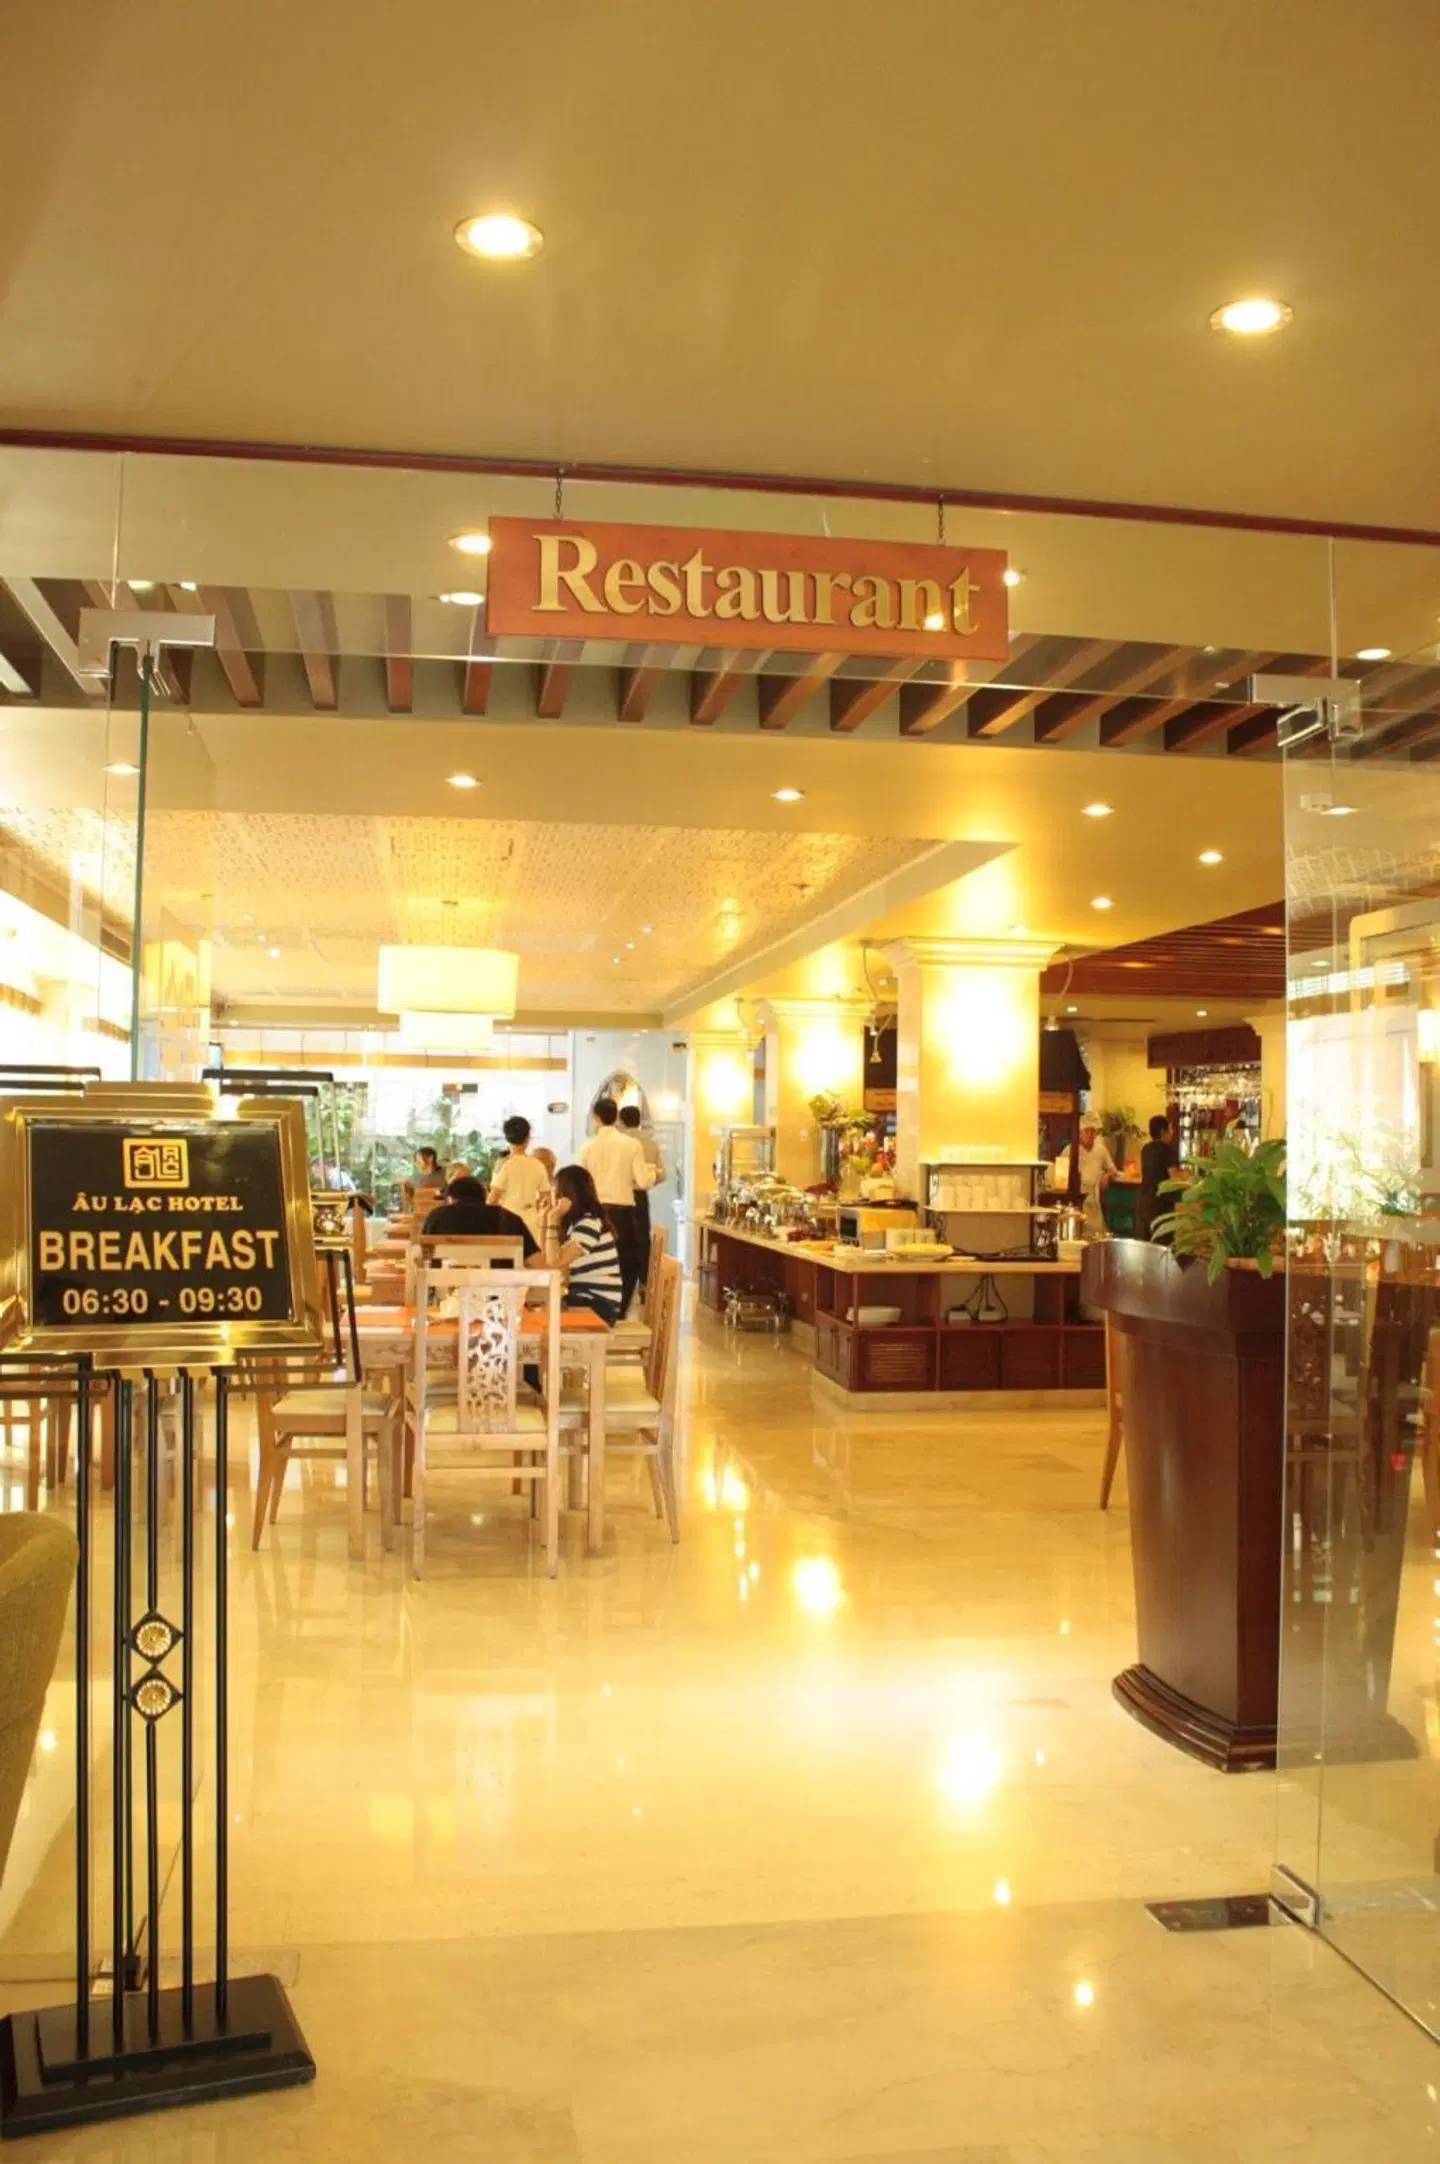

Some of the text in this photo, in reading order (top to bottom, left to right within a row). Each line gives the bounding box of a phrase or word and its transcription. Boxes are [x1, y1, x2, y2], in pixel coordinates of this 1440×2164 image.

[531, 534, 980, 636] Restaurant
[72, 1192, 244, 1214] ÂU LẠC HOTEL
[39, 1230, 279, 1271] BREAKFAST
[63, 1289, 149, 1314] 06:30
[179, 1287, 262, 1312] 09:30
